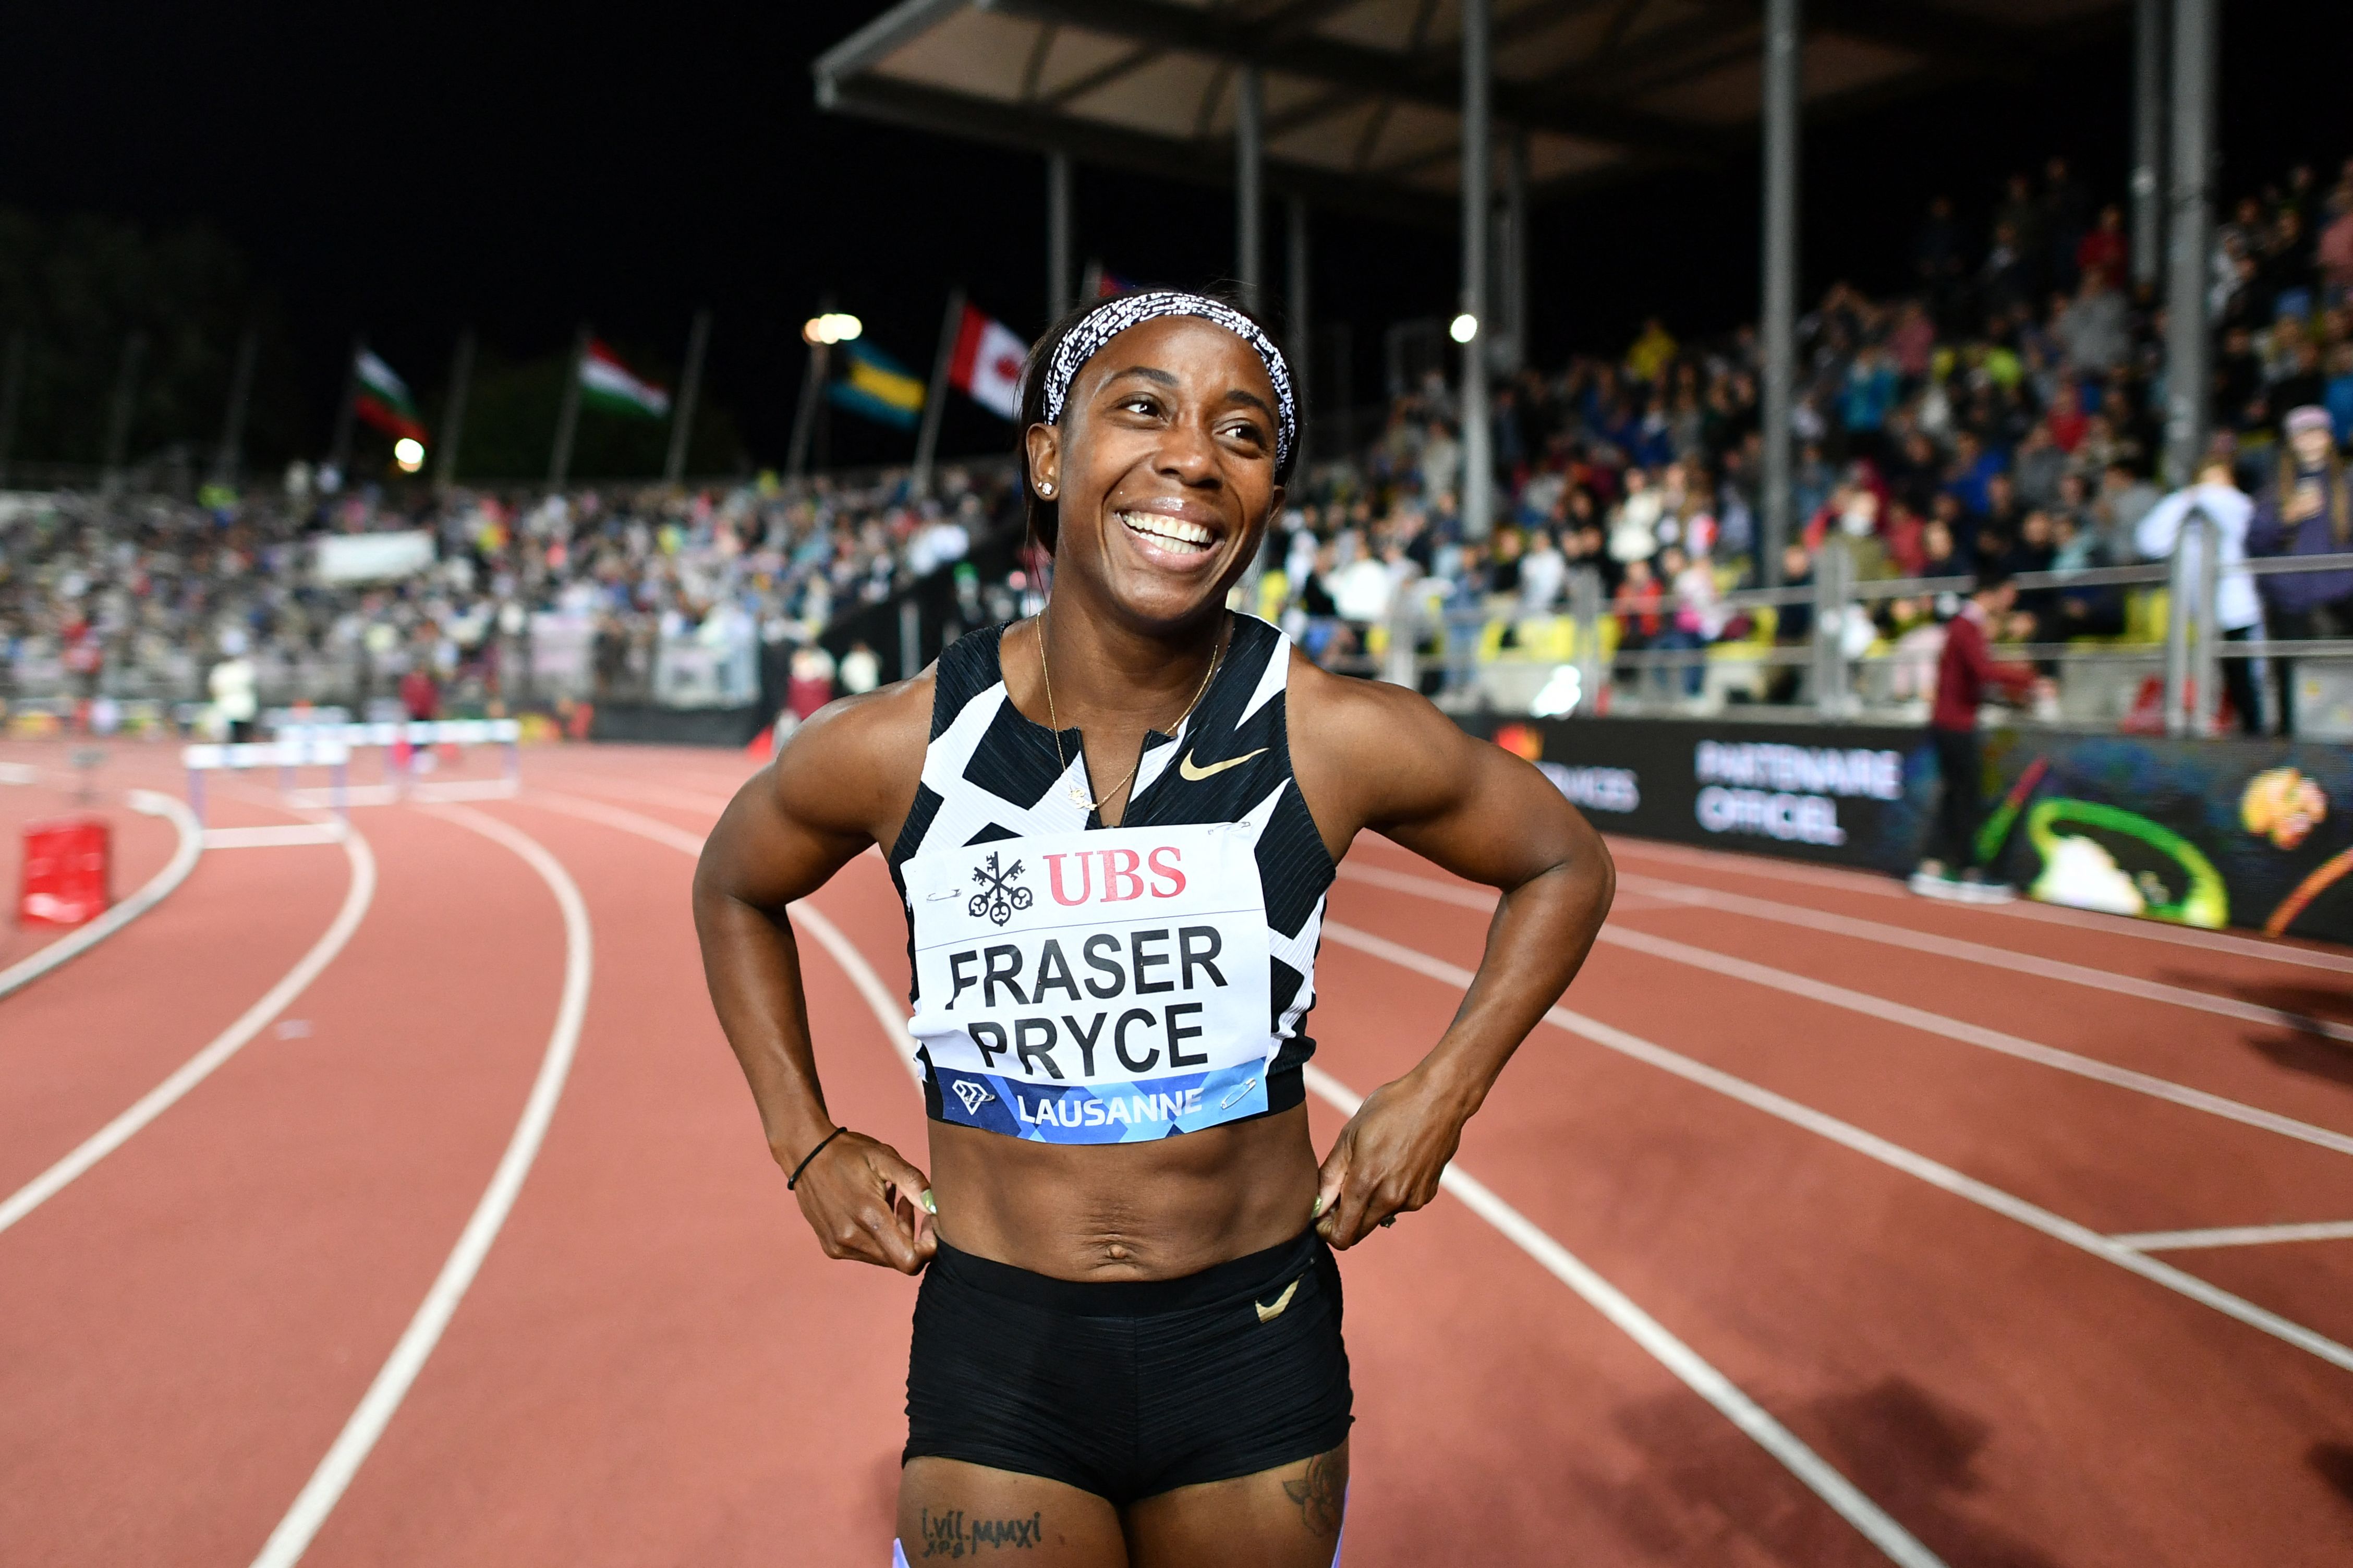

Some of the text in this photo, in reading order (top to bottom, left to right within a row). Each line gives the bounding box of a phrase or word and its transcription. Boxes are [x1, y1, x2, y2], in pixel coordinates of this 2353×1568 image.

[1043, 846, 1186, 906] UBS
[944, 925, 1229, 1010] FRASER
[968, 1002, 1209, 1080] PRYCE
[1016, 1088, 1205, 1127] LAUSANNE
